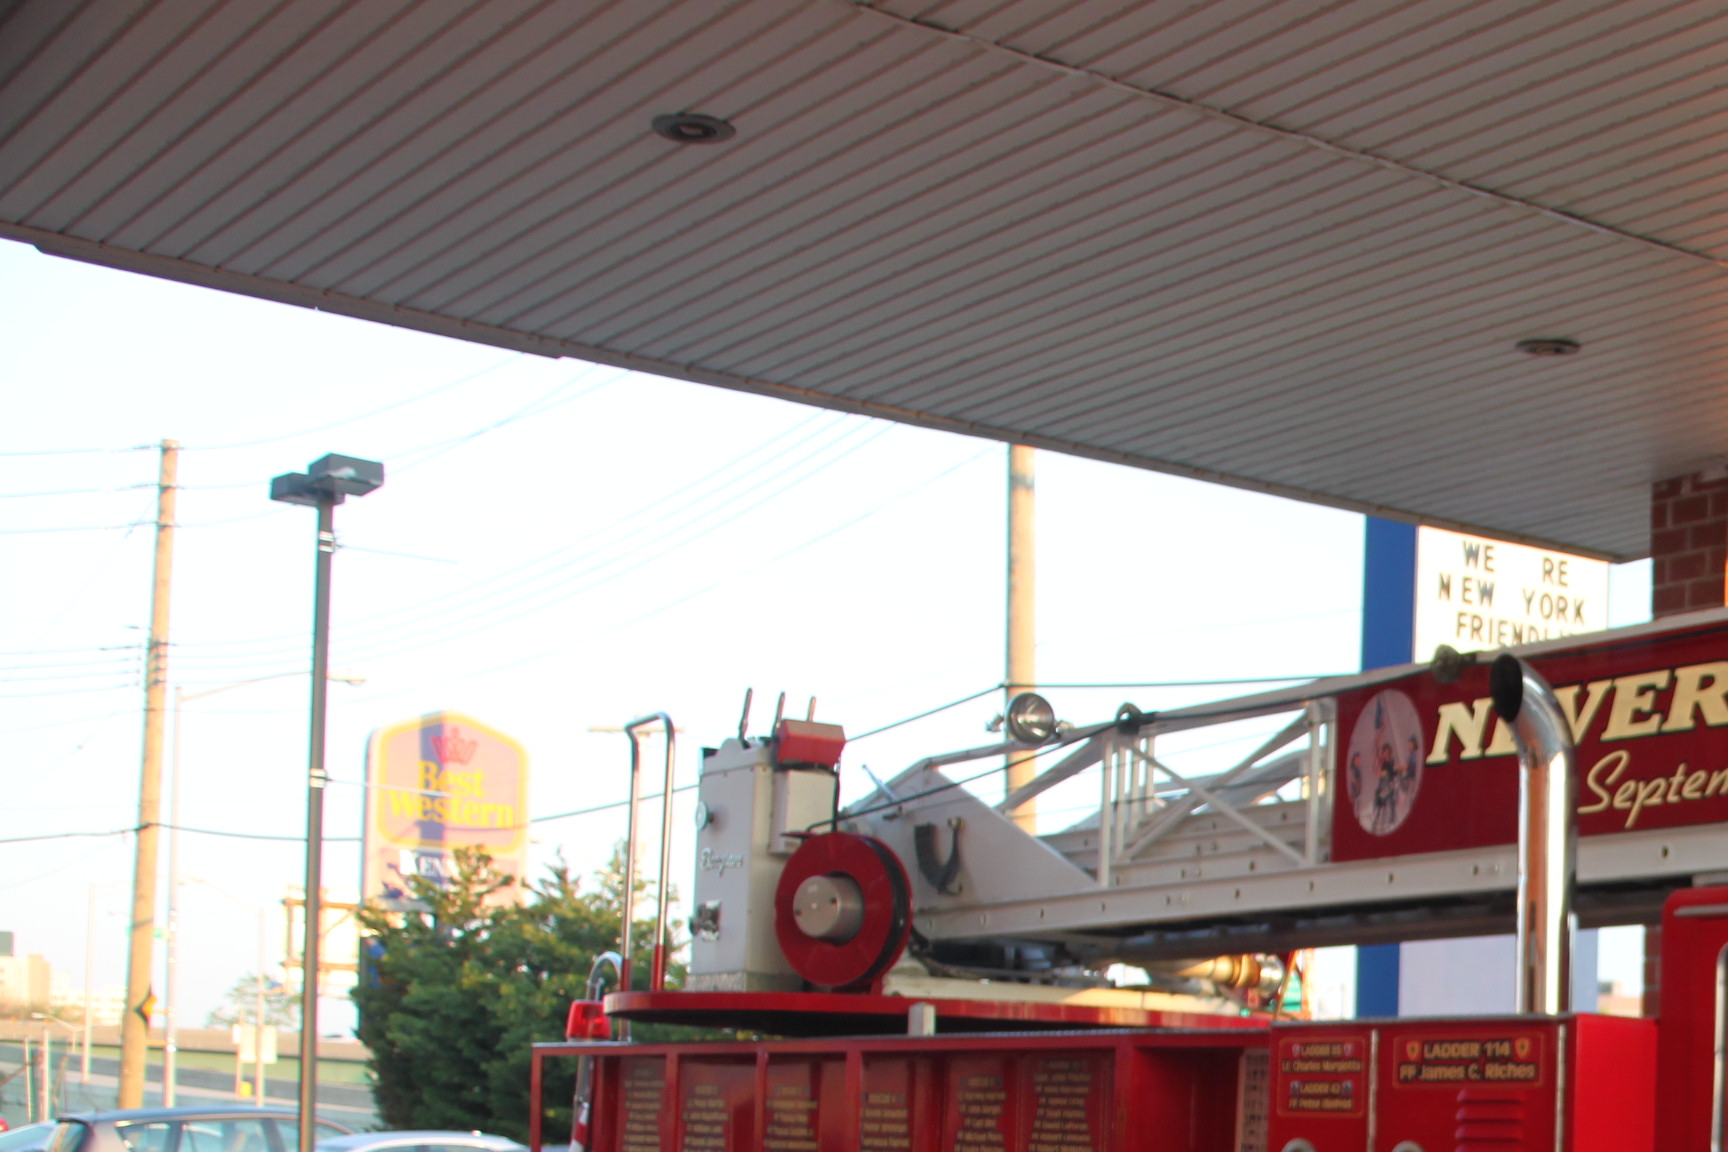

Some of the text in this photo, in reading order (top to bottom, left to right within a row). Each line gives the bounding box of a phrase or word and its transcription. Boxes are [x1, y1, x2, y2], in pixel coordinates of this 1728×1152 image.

[1463, 540, 1569, 587] WE RE
[1439, 572, 1584, 625] NEW YORK
[420, 761, 485, 798] Best
[389, 788, 514, 829] Western
[1423, 1039, 1510, 1059] LADDER 114
[1418, 1063, 1465, 1081] James
[1484, 1062, 1537, 1080] Riches
